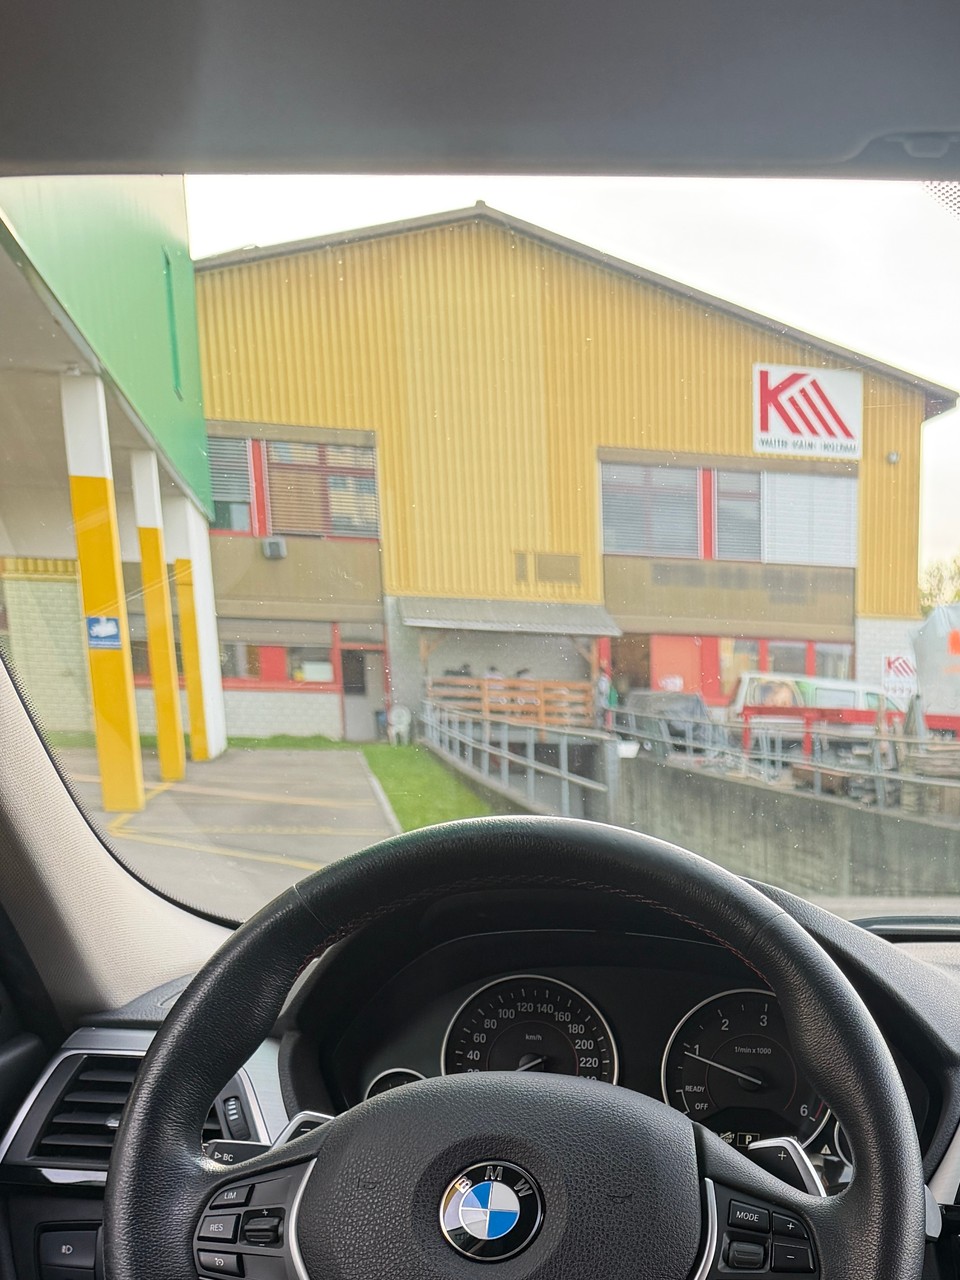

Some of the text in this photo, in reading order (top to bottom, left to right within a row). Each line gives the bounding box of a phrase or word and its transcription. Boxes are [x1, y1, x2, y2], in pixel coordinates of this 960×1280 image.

[517, 1002, 533, 1012] 120
[536, 1004, 554, 1014] 140
[498, 1008, 515, 1019] 100
[554, 1012, 571, 1022] 160
[484, 1019, 497, 1029] 80
[721, 1019, 729, 1031] 2
[759, 1015, 767, 1027] 3
[567, 1024, 585, 1034] 180
[473, 1033, 486, 1043] 60
[525, 1033, 542, 1041] km/h
[575, 1040, 594, 1049] 200
[694, 1044, 700, 1056] 1
[467, 1050, 480, 1061] 40
[579, 1057, 598, 1067] 220
[685, 1085, 705, 1093] READY
[800, 1105, 808, 1117] 6
[745, 1135, 752, 1145] P
[223, 1153, 234, 1161] BC
[454, 1166, 533, 1197] BMW
[224, 1191, 237, 1199] LIM
[736, 1211, 759, 1222] MODE
[209, 1223, 224, 1232] RES
